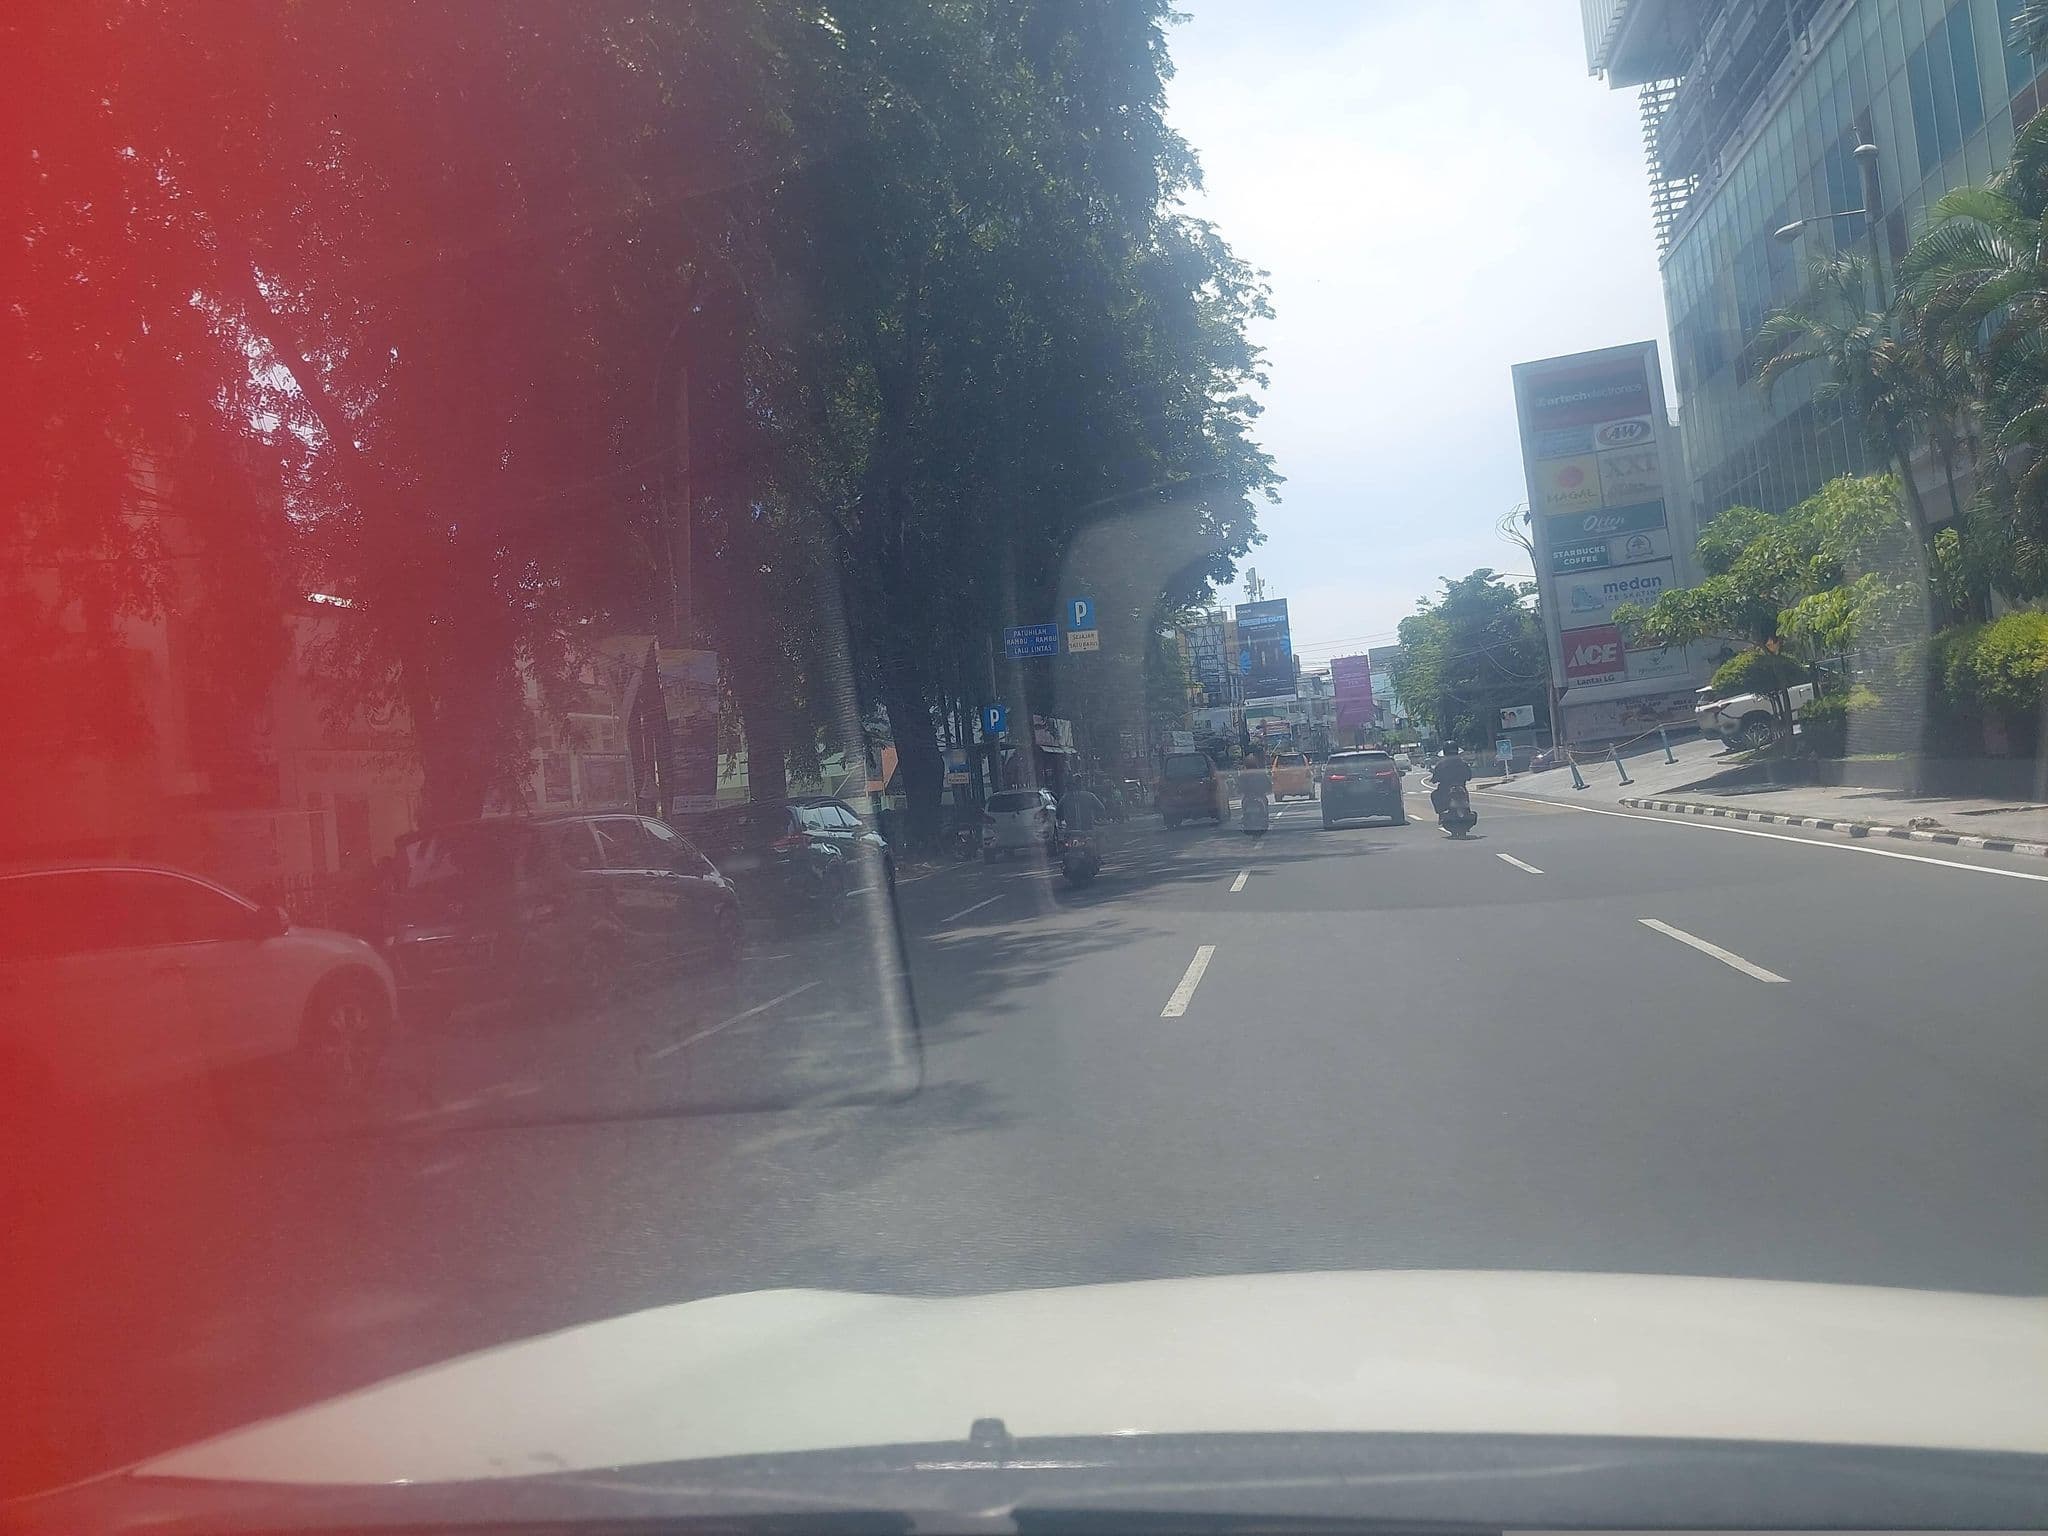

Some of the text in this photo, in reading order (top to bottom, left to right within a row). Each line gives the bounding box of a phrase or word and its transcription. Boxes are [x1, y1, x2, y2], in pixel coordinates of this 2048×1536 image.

[1552, 545, 1606, 560] STARBUCKS
[1563, 555, 1599, 566] COFFEE
[1603, 576, 1662, 594] medan
[1074, 601, 1087, 626] P
[1006, 635, 1057, 646] RAMBU RAMBU
[1014, 645, 1052, 655] LALU LINTAS
[1567, 642, 1618, 668] ACE
[1576, 674, 1615, 686] Lantai LG
[989, 708, 1000, 730] P
